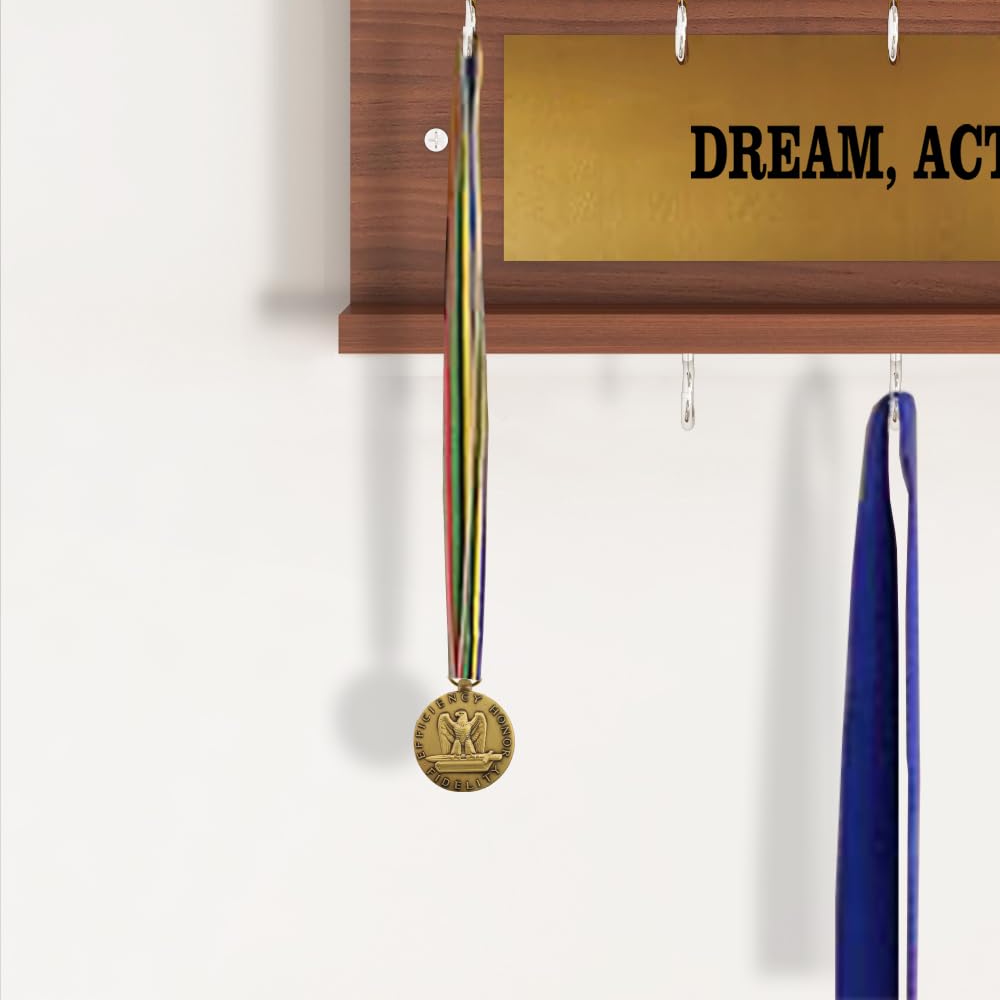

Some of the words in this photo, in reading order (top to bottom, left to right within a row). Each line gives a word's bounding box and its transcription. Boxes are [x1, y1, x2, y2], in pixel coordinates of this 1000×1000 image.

[690, 125, 896, 190] DREAM,
[415, 692, 482, 761] EFFICIENCY
[488, 704, 512, 758] HONOR
[425, 764, 501, 791] FIDELITY
